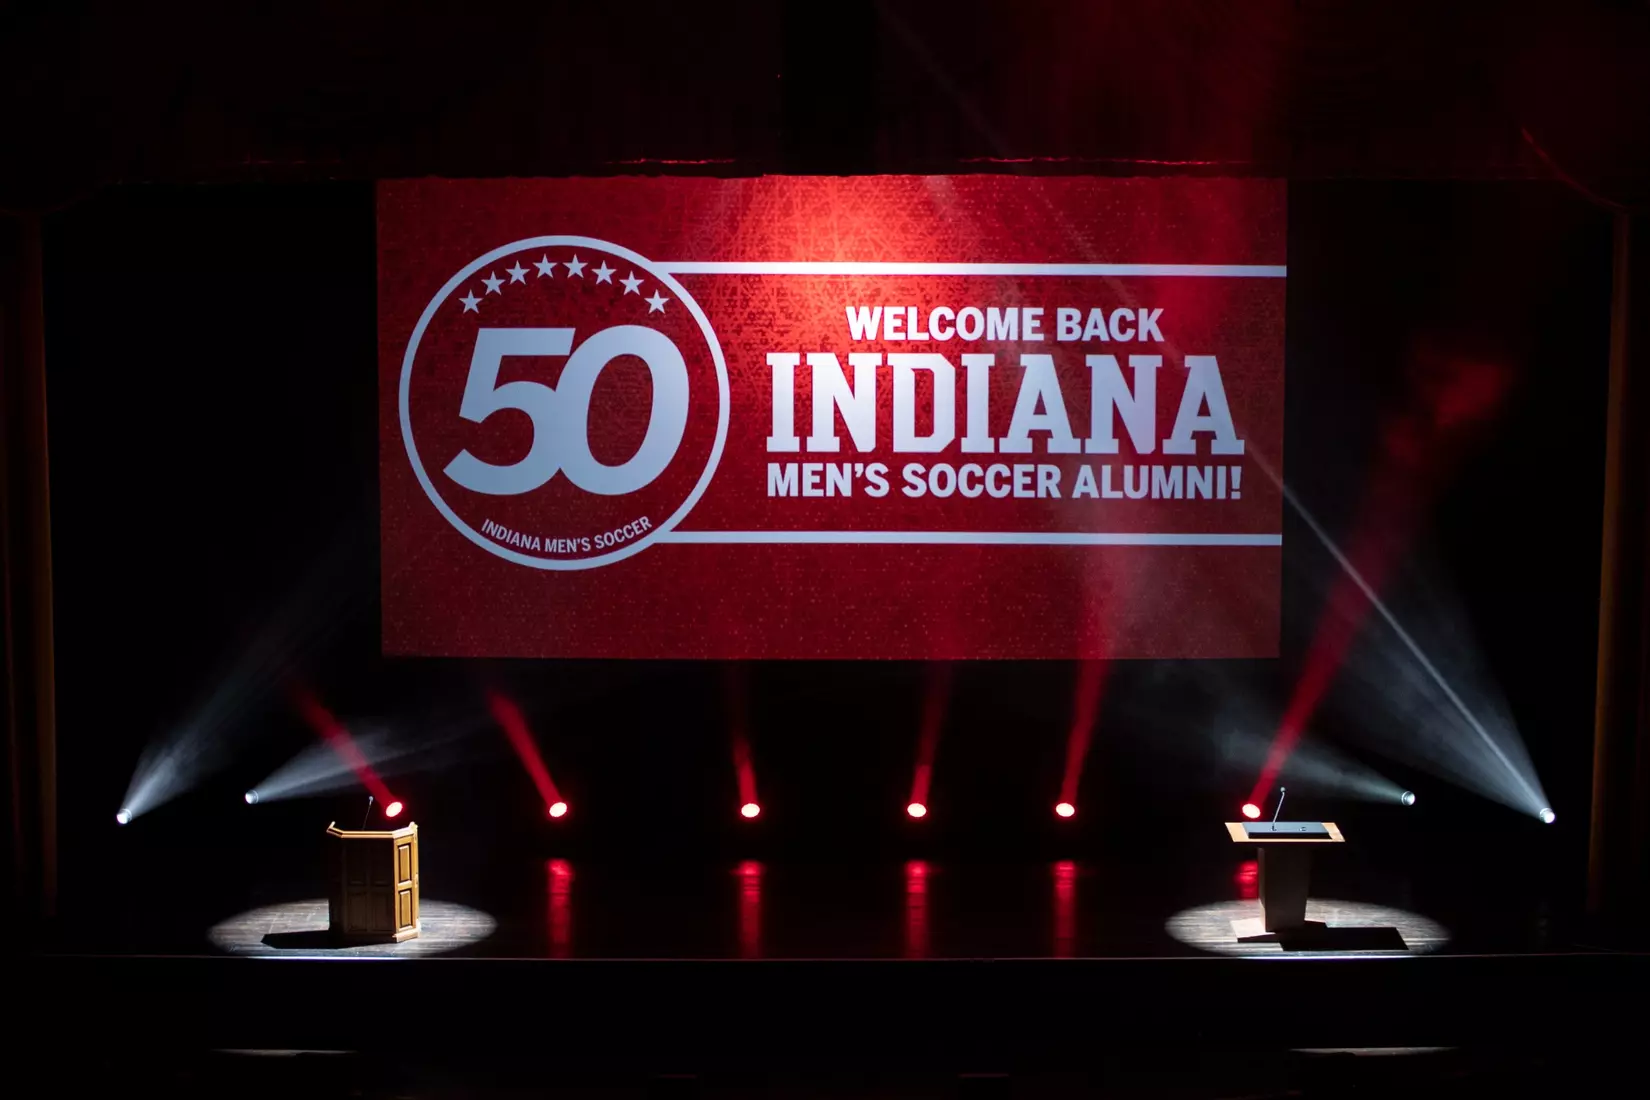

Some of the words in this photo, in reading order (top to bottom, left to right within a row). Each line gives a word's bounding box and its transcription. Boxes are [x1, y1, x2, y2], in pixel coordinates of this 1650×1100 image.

[845, 306, 1045, 342] WELCOME
[1056, 307, 1165, 342] BACK
[442, 324, 690, 496] 50
[766, 352, 1246, 455] INDIANA
[766, 462, 890, 498] MEN'S
[901, 462, 1062, 499] SOCCER
[1071, 464, 1242, 500] ALUMNI!
[481, 518, 541, 551] INDIANA
[544, 537, 591, 553] MEN'S
[595, 515, 652, 549] SOCCER
